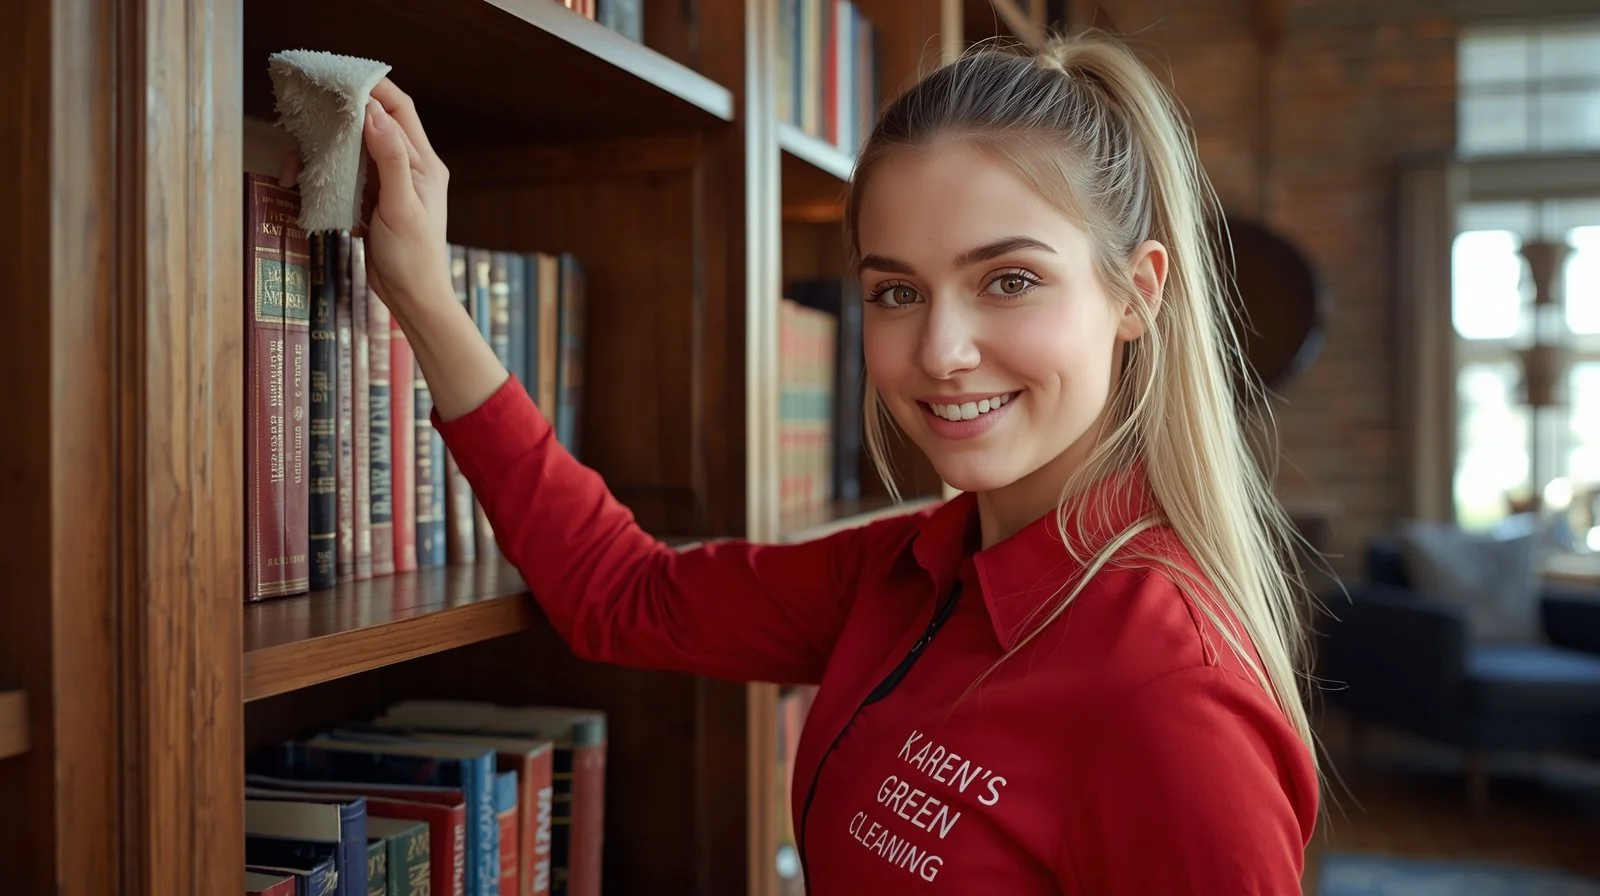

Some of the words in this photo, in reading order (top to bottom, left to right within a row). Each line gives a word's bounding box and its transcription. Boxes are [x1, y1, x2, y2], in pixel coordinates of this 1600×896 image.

[898, 730, 1007, 806] KAREN'S
[877, 775, 961, 839] GREEN
[849, 811, 943, 882] CLEANING
